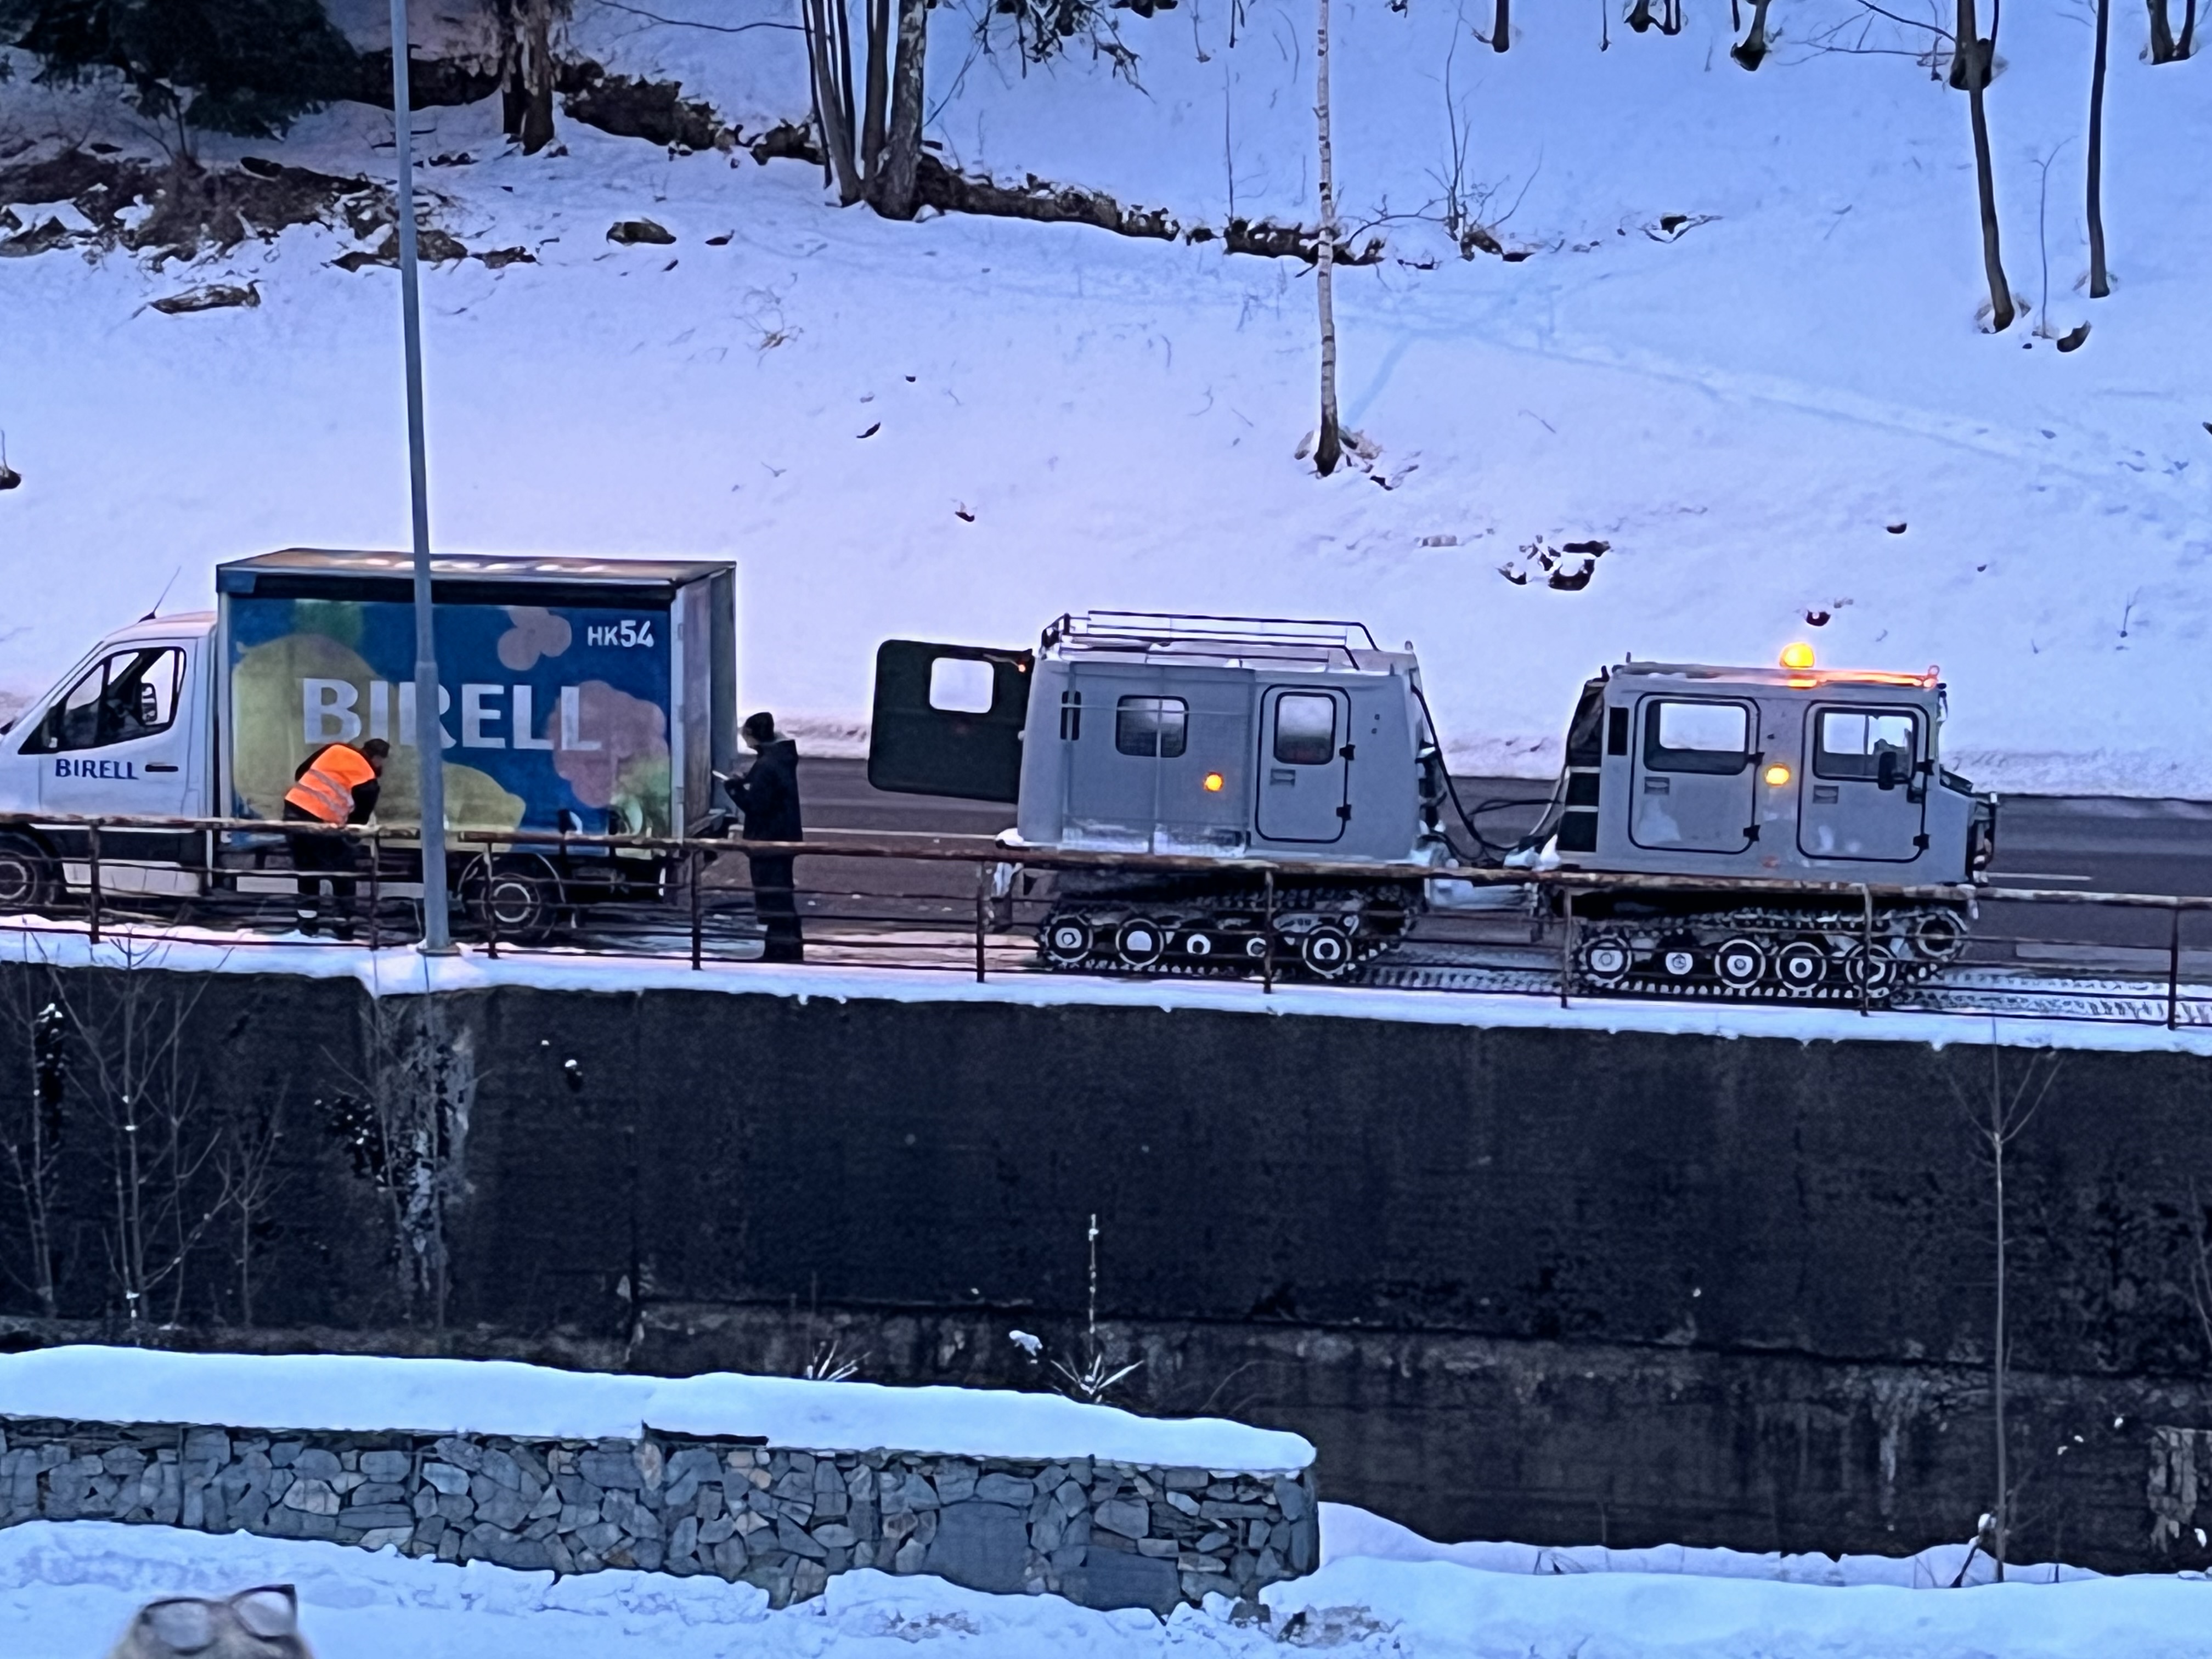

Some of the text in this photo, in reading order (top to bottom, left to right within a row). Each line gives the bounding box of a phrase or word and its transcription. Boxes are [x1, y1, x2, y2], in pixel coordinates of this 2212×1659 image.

[588, 620, 654, 647] HK54
[303, 678, 602, 751] BIRELL
[55, 759, 139, 780] BIRELL
